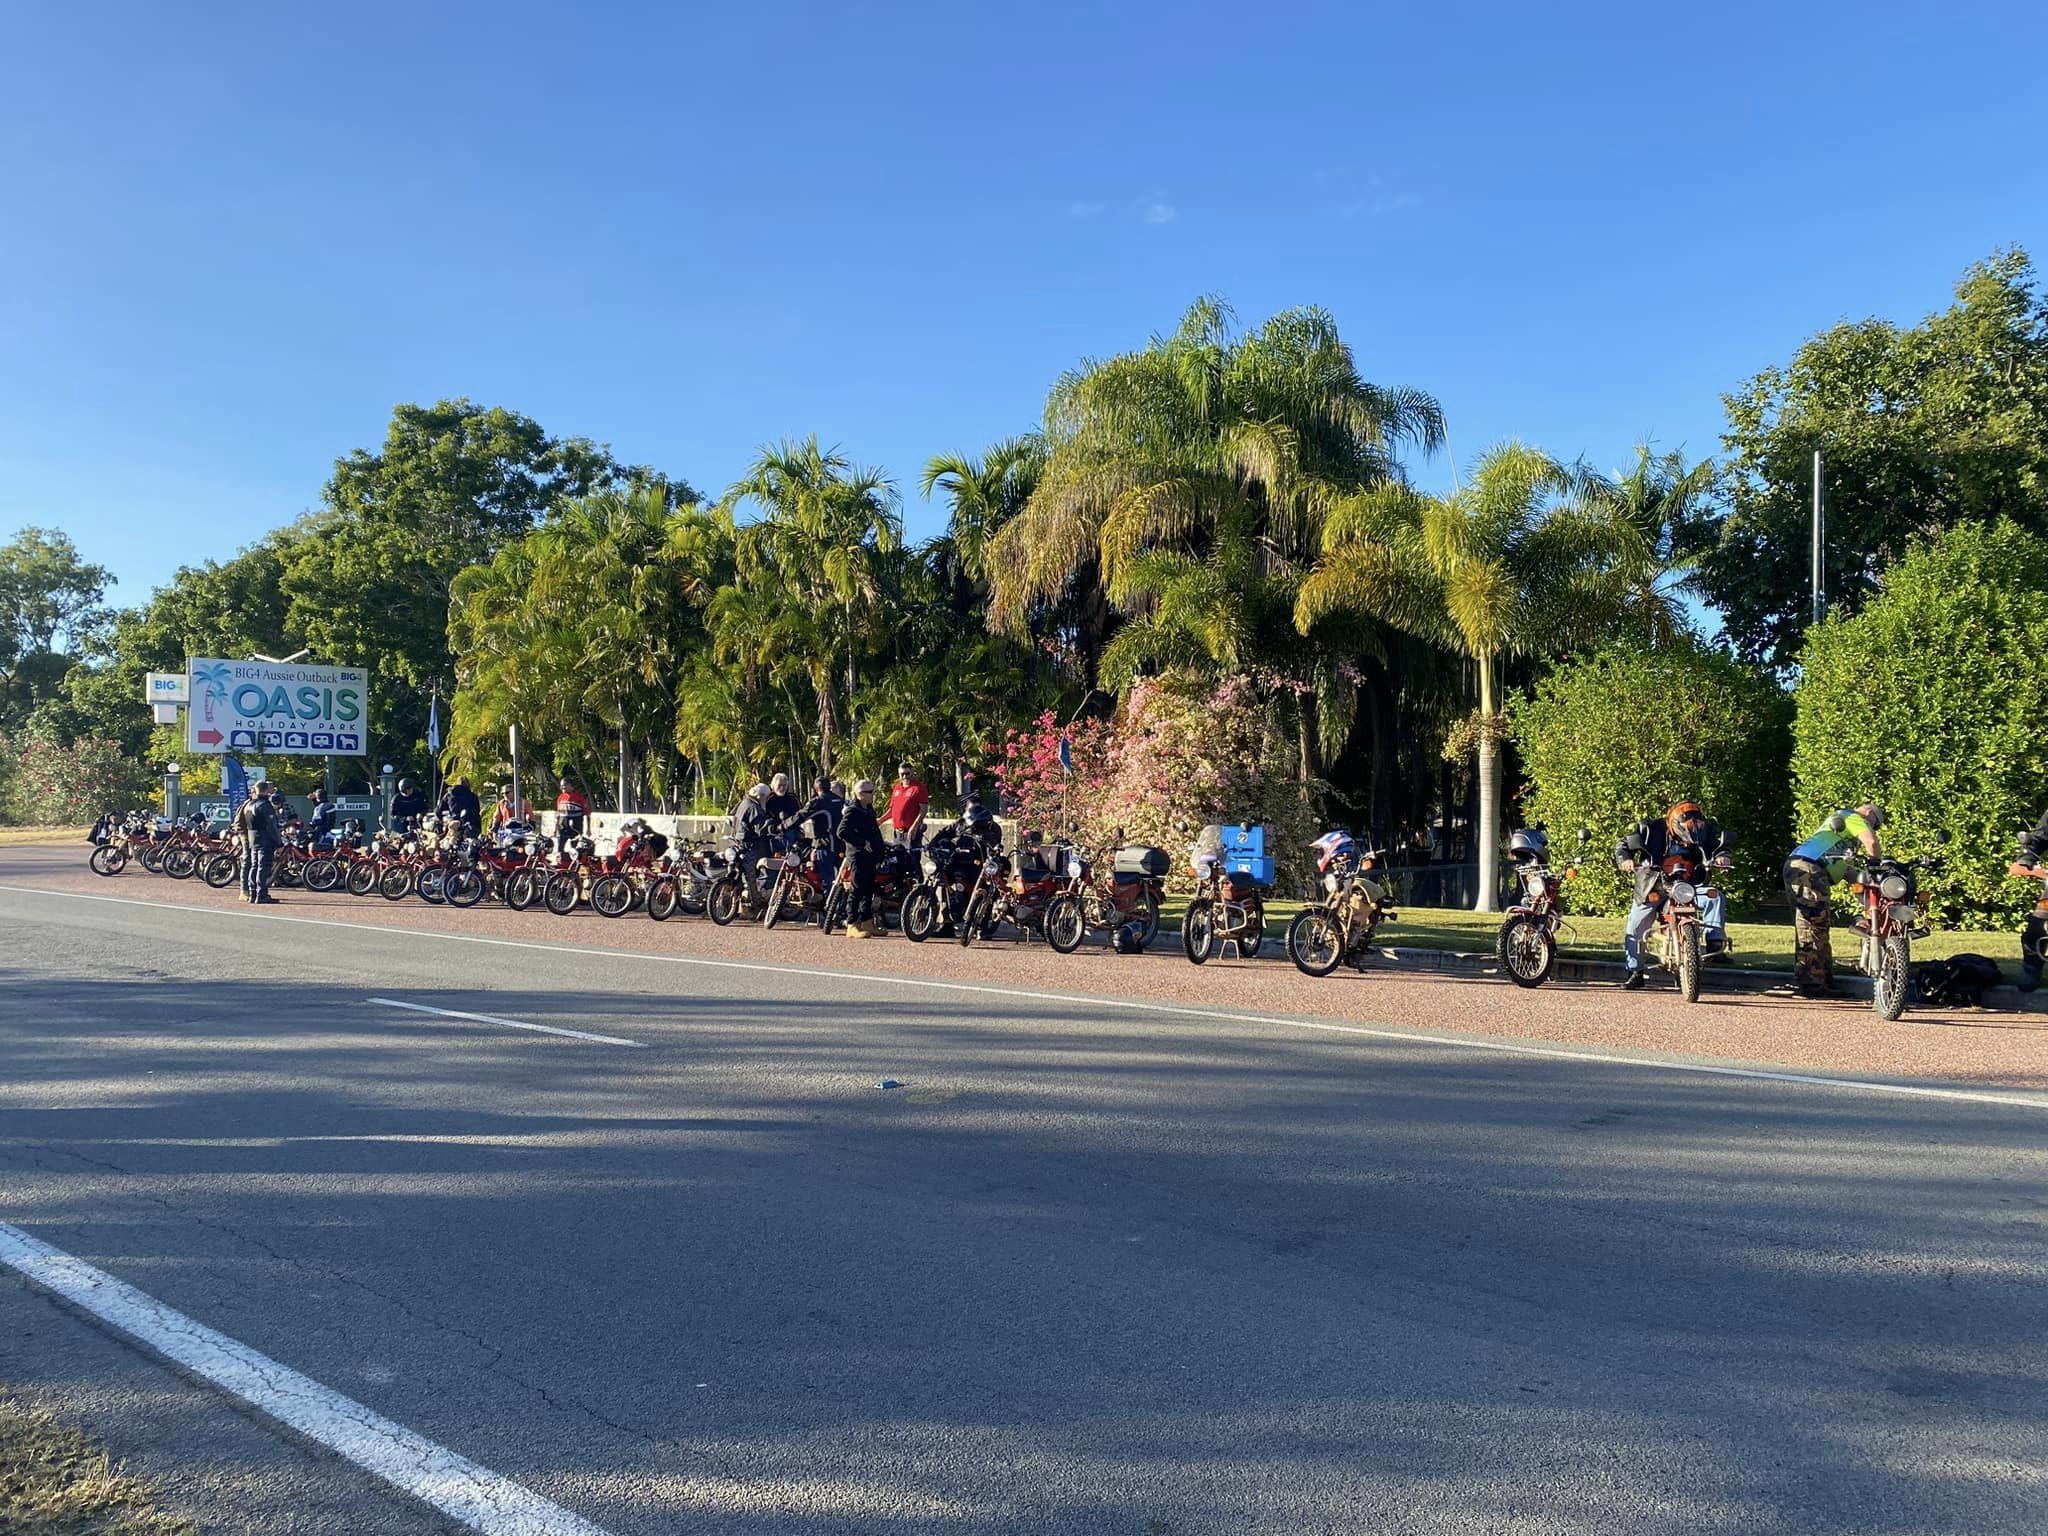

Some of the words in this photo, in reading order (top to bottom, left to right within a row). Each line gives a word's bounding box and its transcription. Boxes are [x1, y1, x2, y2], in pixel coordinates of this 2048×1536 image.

[235, 667, 260, 679] BIG4
[264, 670, 295, 682] Aussie
[297, 671, 338, 684] Outback
[155, 680, 183, 689] BIG4
[232, 683, 360, 722] OASIS
[235, 720, 306, 730] HOLIDAY
[319, 722, 356, 731] PARK
